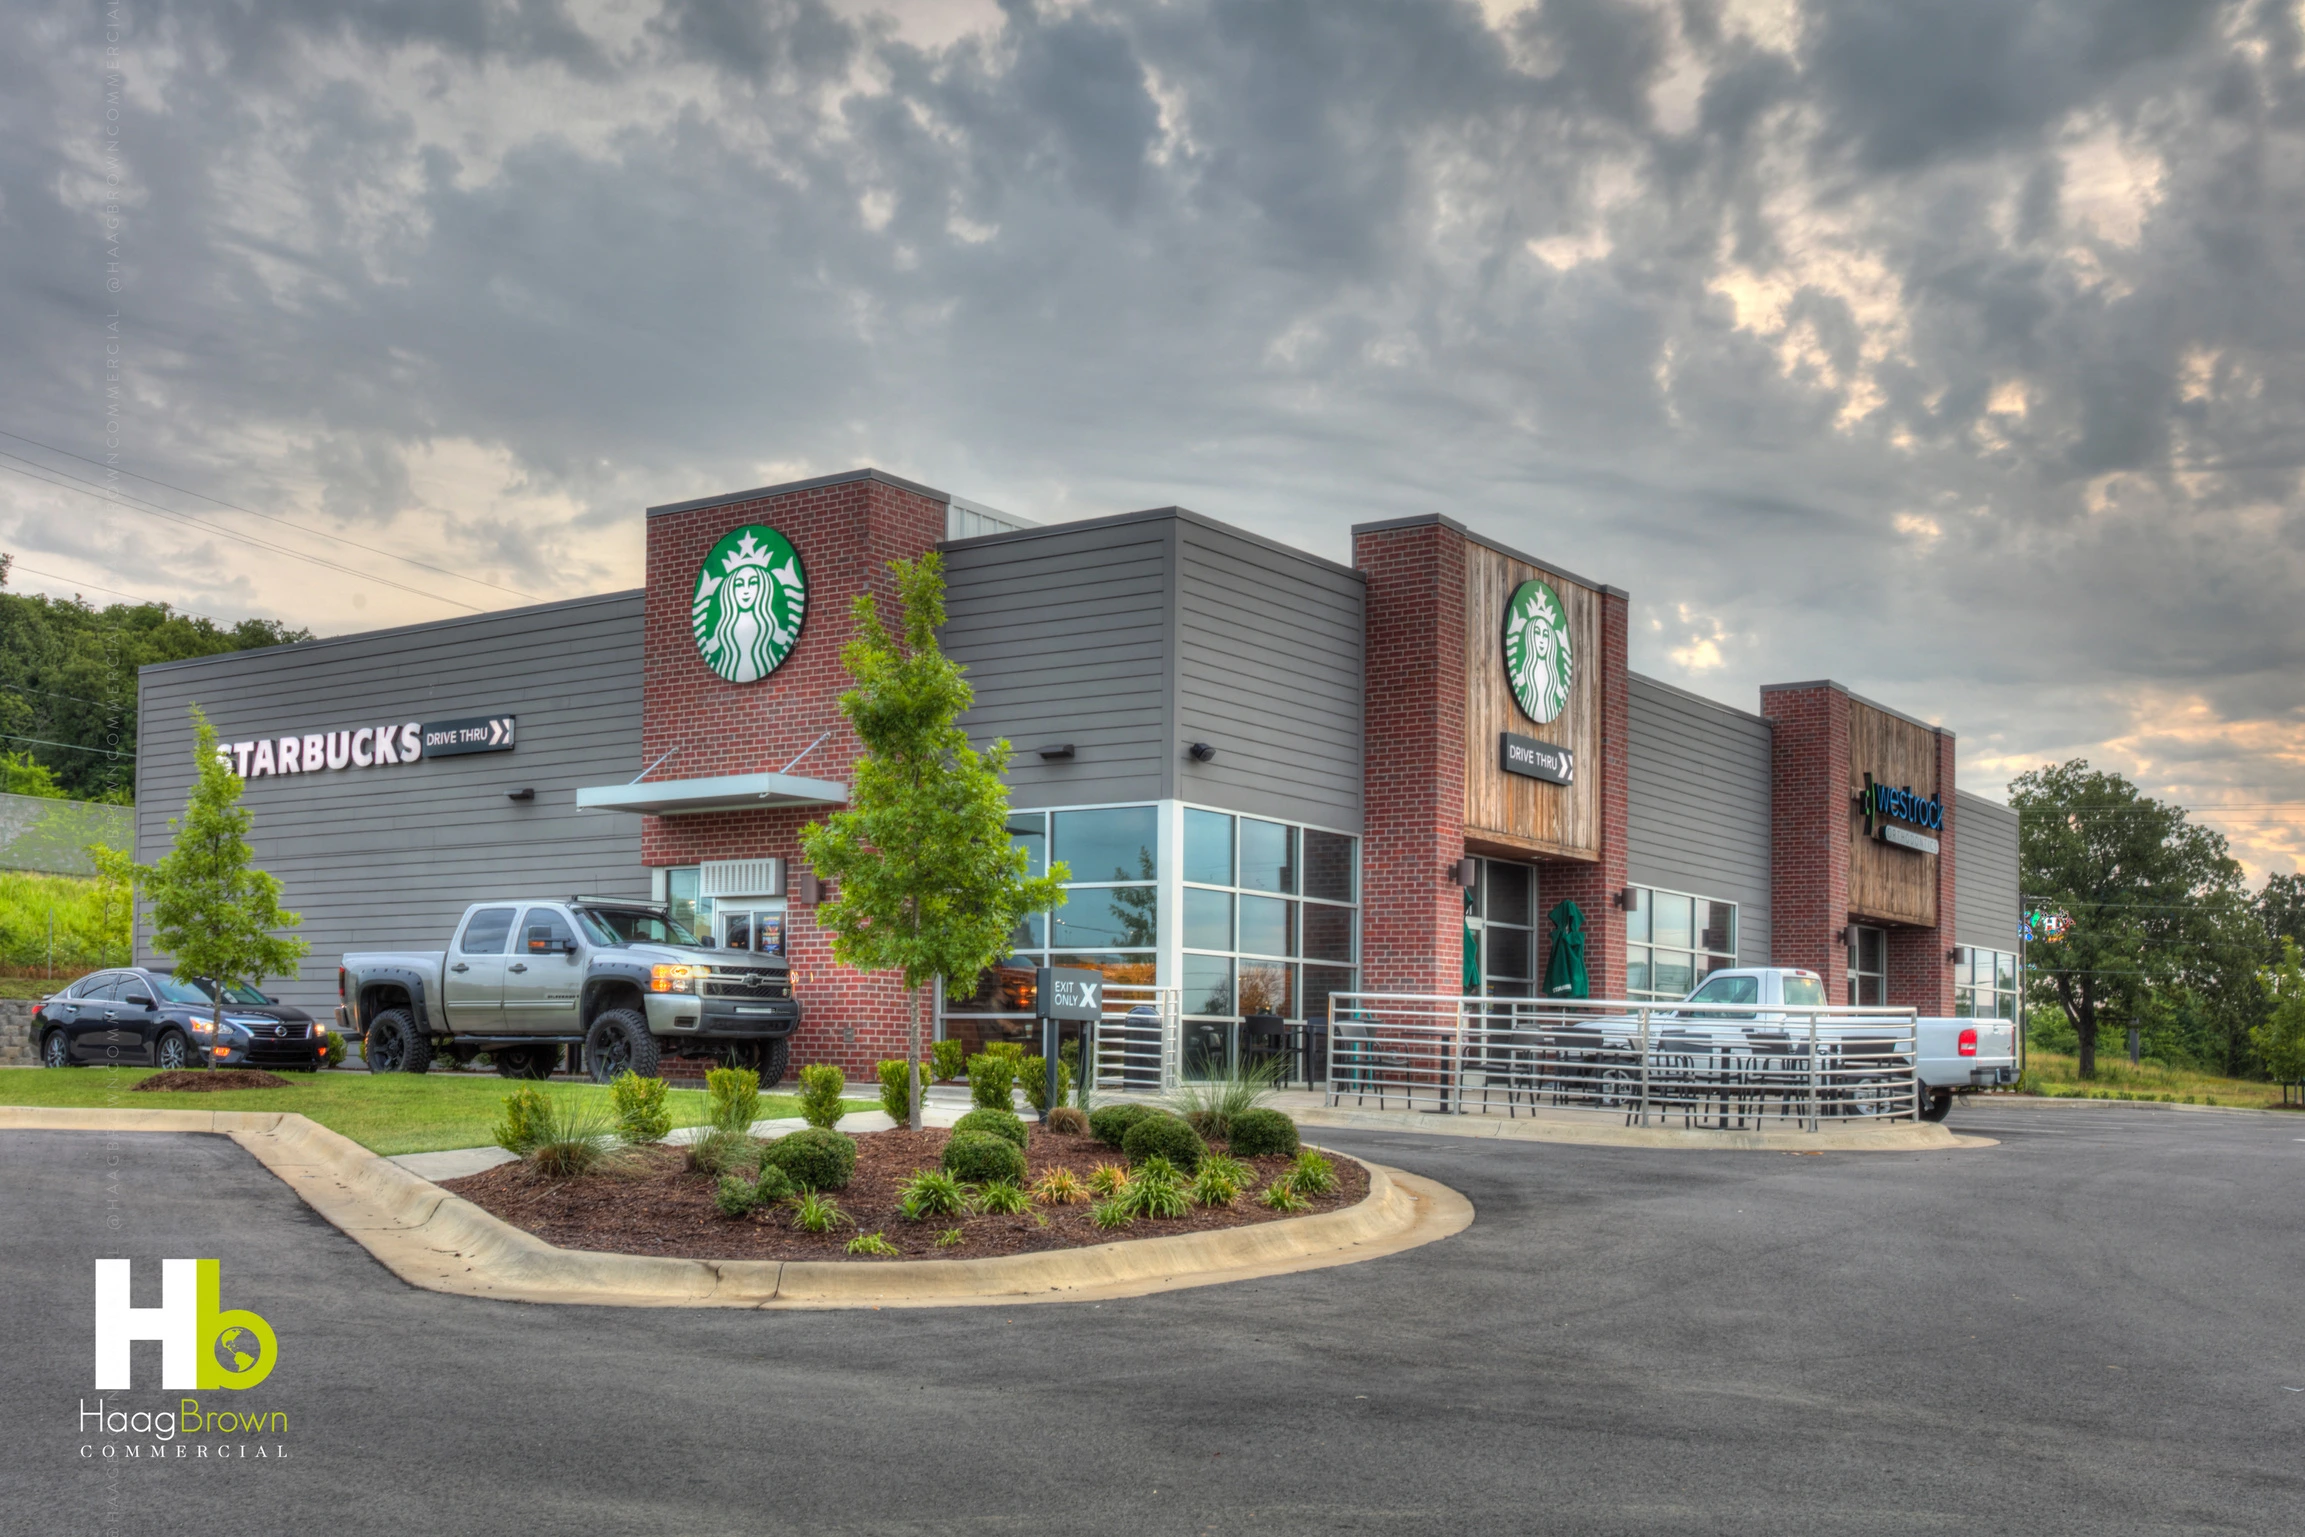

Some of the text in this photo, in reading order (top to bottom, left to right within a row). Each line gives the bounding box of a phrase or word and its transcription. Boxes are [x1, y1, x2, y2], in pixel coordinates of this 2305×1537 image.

[426, 727, 488, 746] DRIVE THRU
[215, 722, 422, 777] STARBUCKS
[1509, 744, 1558, 770] DRIVE THRU
[1876, 783, 1944, 831] westrock
[1054, 981, 1074, 993] EXIT
[1054, 993, 1078, 1007] ONLY
